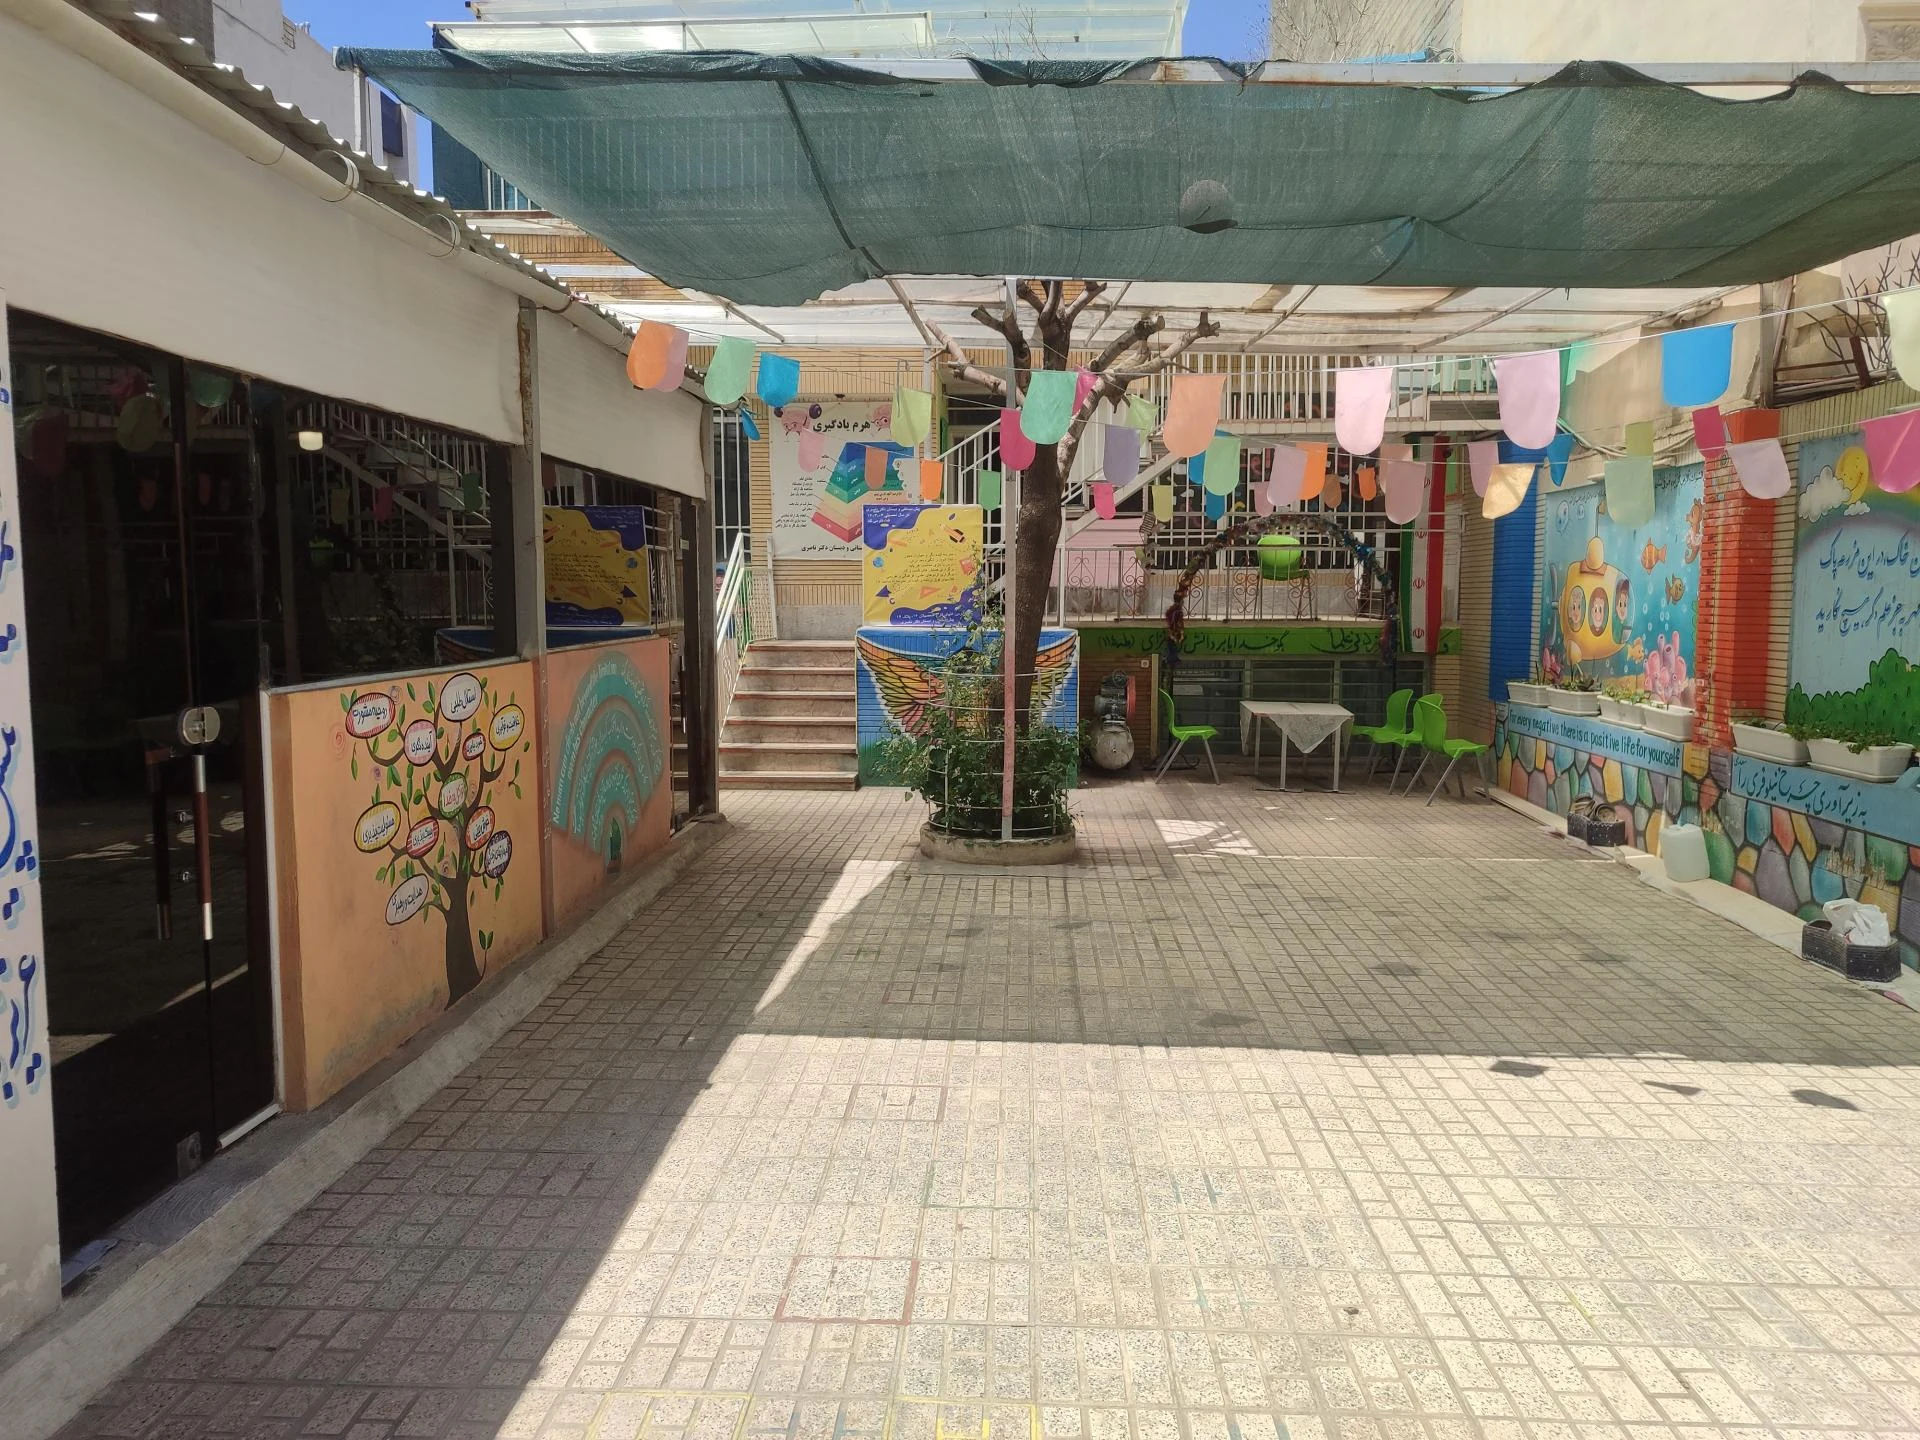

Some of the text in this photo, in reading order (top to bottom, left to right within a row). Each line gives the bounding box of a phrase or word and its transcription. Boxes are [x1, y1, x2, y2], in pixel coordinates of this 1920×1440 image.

[812, 418, 871, 433] هرم یادگیری
[1517, 714, 1532, 731] every
[1532, 718, 1559, 737] negative
[1560, 721, 1576, 740] there
[1576, 724, 1583, 742] is
[1583, 730, 1589, 742] a
[1590, 731, 1620, 752] positive
[1621, 735, 1635, 756] life
[1636, 737, 1648, 759] for
[1648, 746, 1681, 768] yourself
[1737, 768, 1747, 788] را
